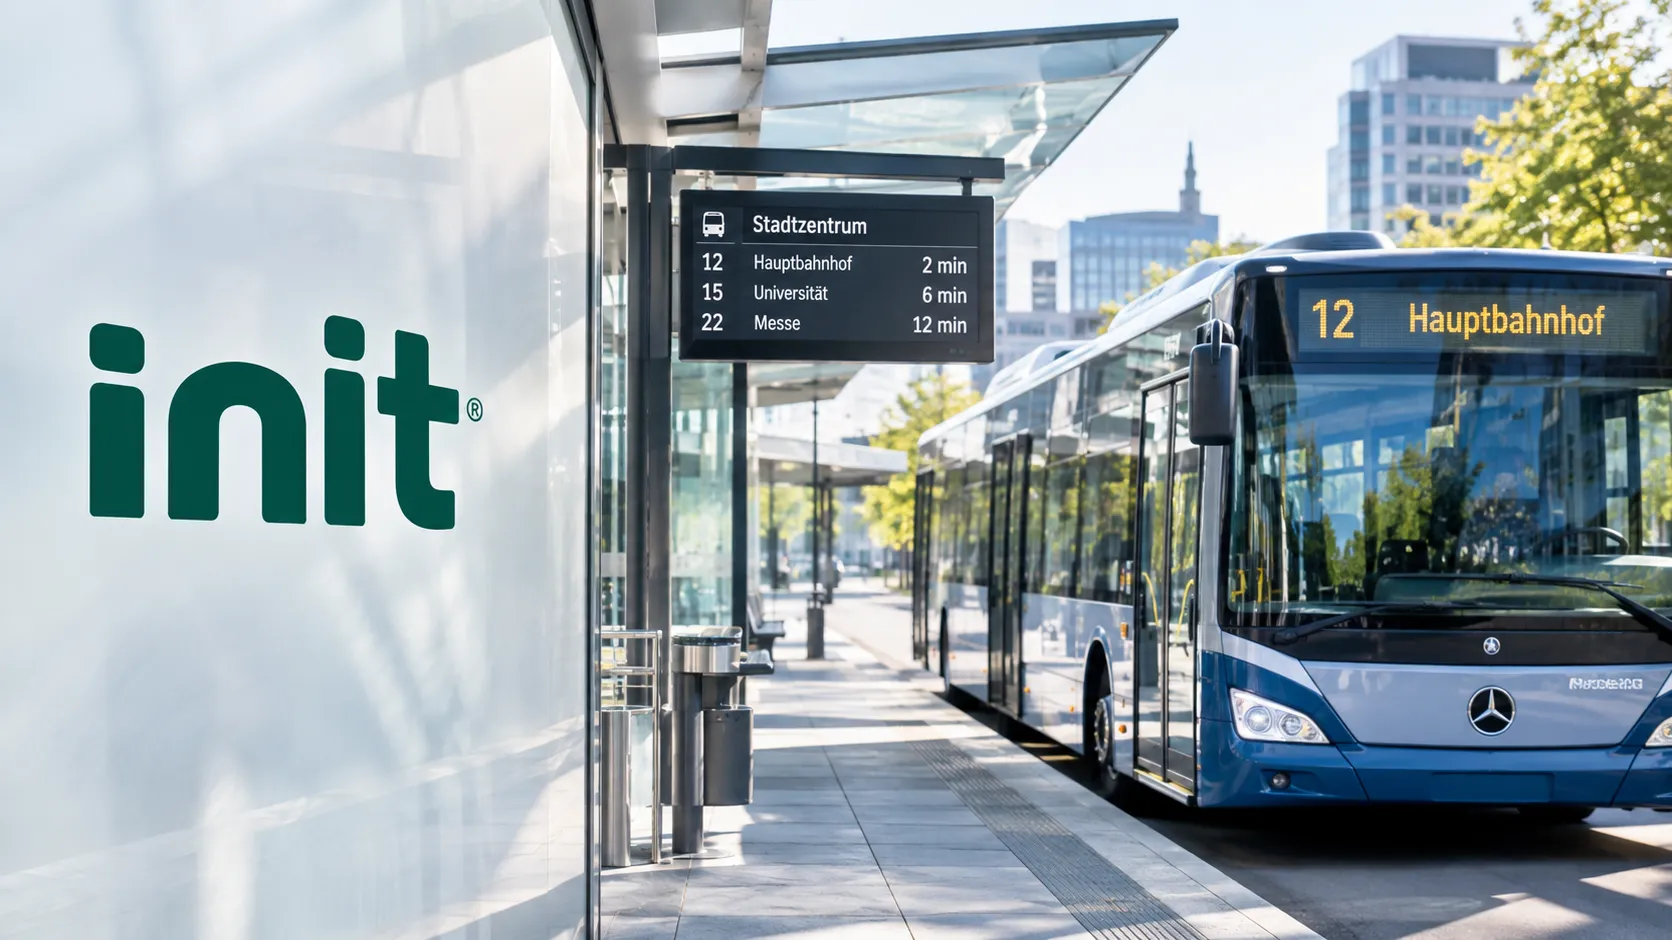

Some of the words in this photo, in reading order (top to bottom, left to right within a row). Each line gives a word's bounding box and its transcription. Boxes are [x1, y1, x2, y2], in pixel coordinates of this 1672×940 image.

[753, 214, 868, 236] Stadtzentrum
[702, 252, 724, 272] 12
[754, 253, 854, 275] Hauptbahnhof
[922, 256, 933, 274] 2
[937, 256, 968, 275] min
[702, 283, 724, 302] 15
[754, 284, 829, 302] Universität
[922, 286, 933, 304] 6
[937, 286, 968, 304] min
[702, 313, 724, 332] 22
[754, 314, 801, 332] Messe
[912, 316, 933, 334] 12
[937, 316, 968, 334] min
[1312, 299, 1355, 339] 12
[1409, 303, 1606, 341] Hauptbahnhof
